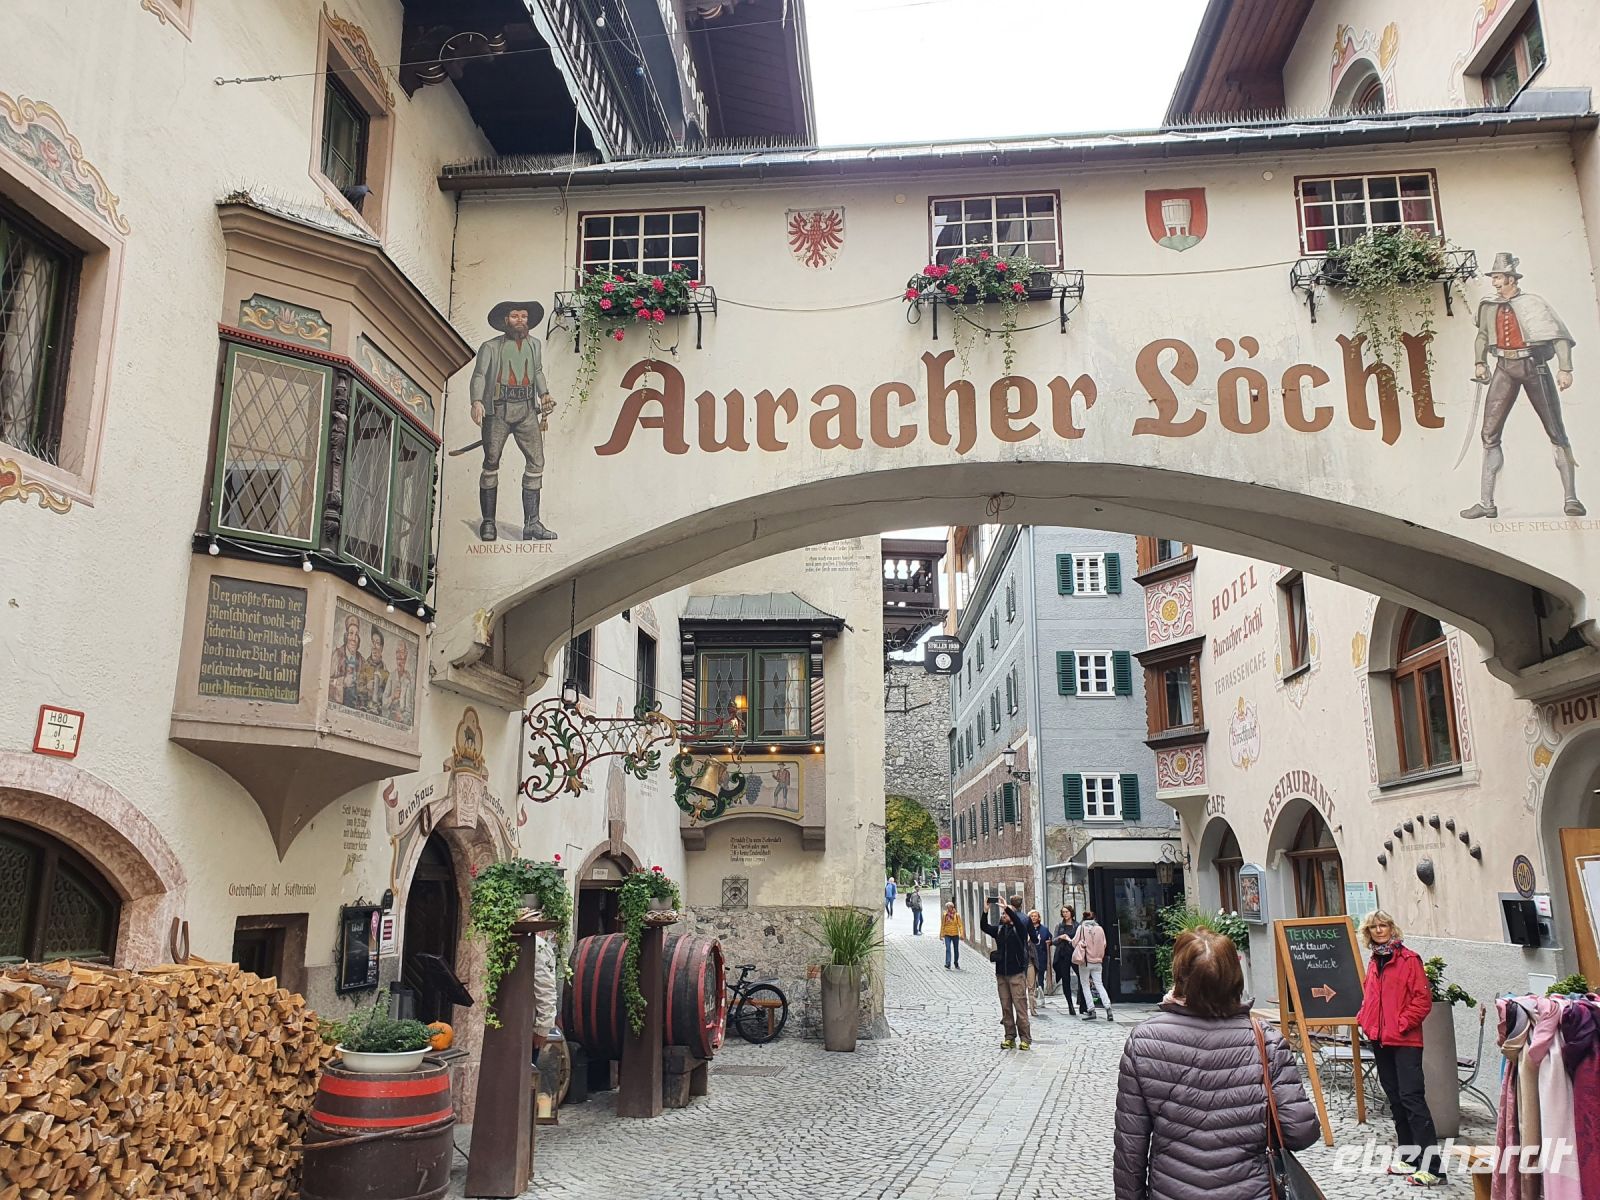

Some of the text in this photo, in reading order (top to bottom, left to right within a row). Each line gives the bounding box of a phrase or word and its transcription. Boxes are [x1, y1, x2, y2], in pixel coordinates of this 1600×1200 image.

[593, 333, 1446, 455] Auracher Löchl
[1489, 519, 1600, 533] JOSEF SPECKBACH
[466, 543, 553, 554] ANDREAS HOFER
[1212, 565, 1257, 620] HOTEL
[261, 593, 285, 609] Feind
[288, 598, 302, 611] der
[248, 629, 262, 642] der
[225, 644, 234, 656] in
[236, 644, 250, 658] der
[252, 645, 276, 661] Bibel
[50, 712, 68, 724] H80
[398, 784, 434, 825] Weinhaus
[1263, 769, 1336, 834] RESTAURANT
[1287, 928, 1342, 941] TERRASSE
